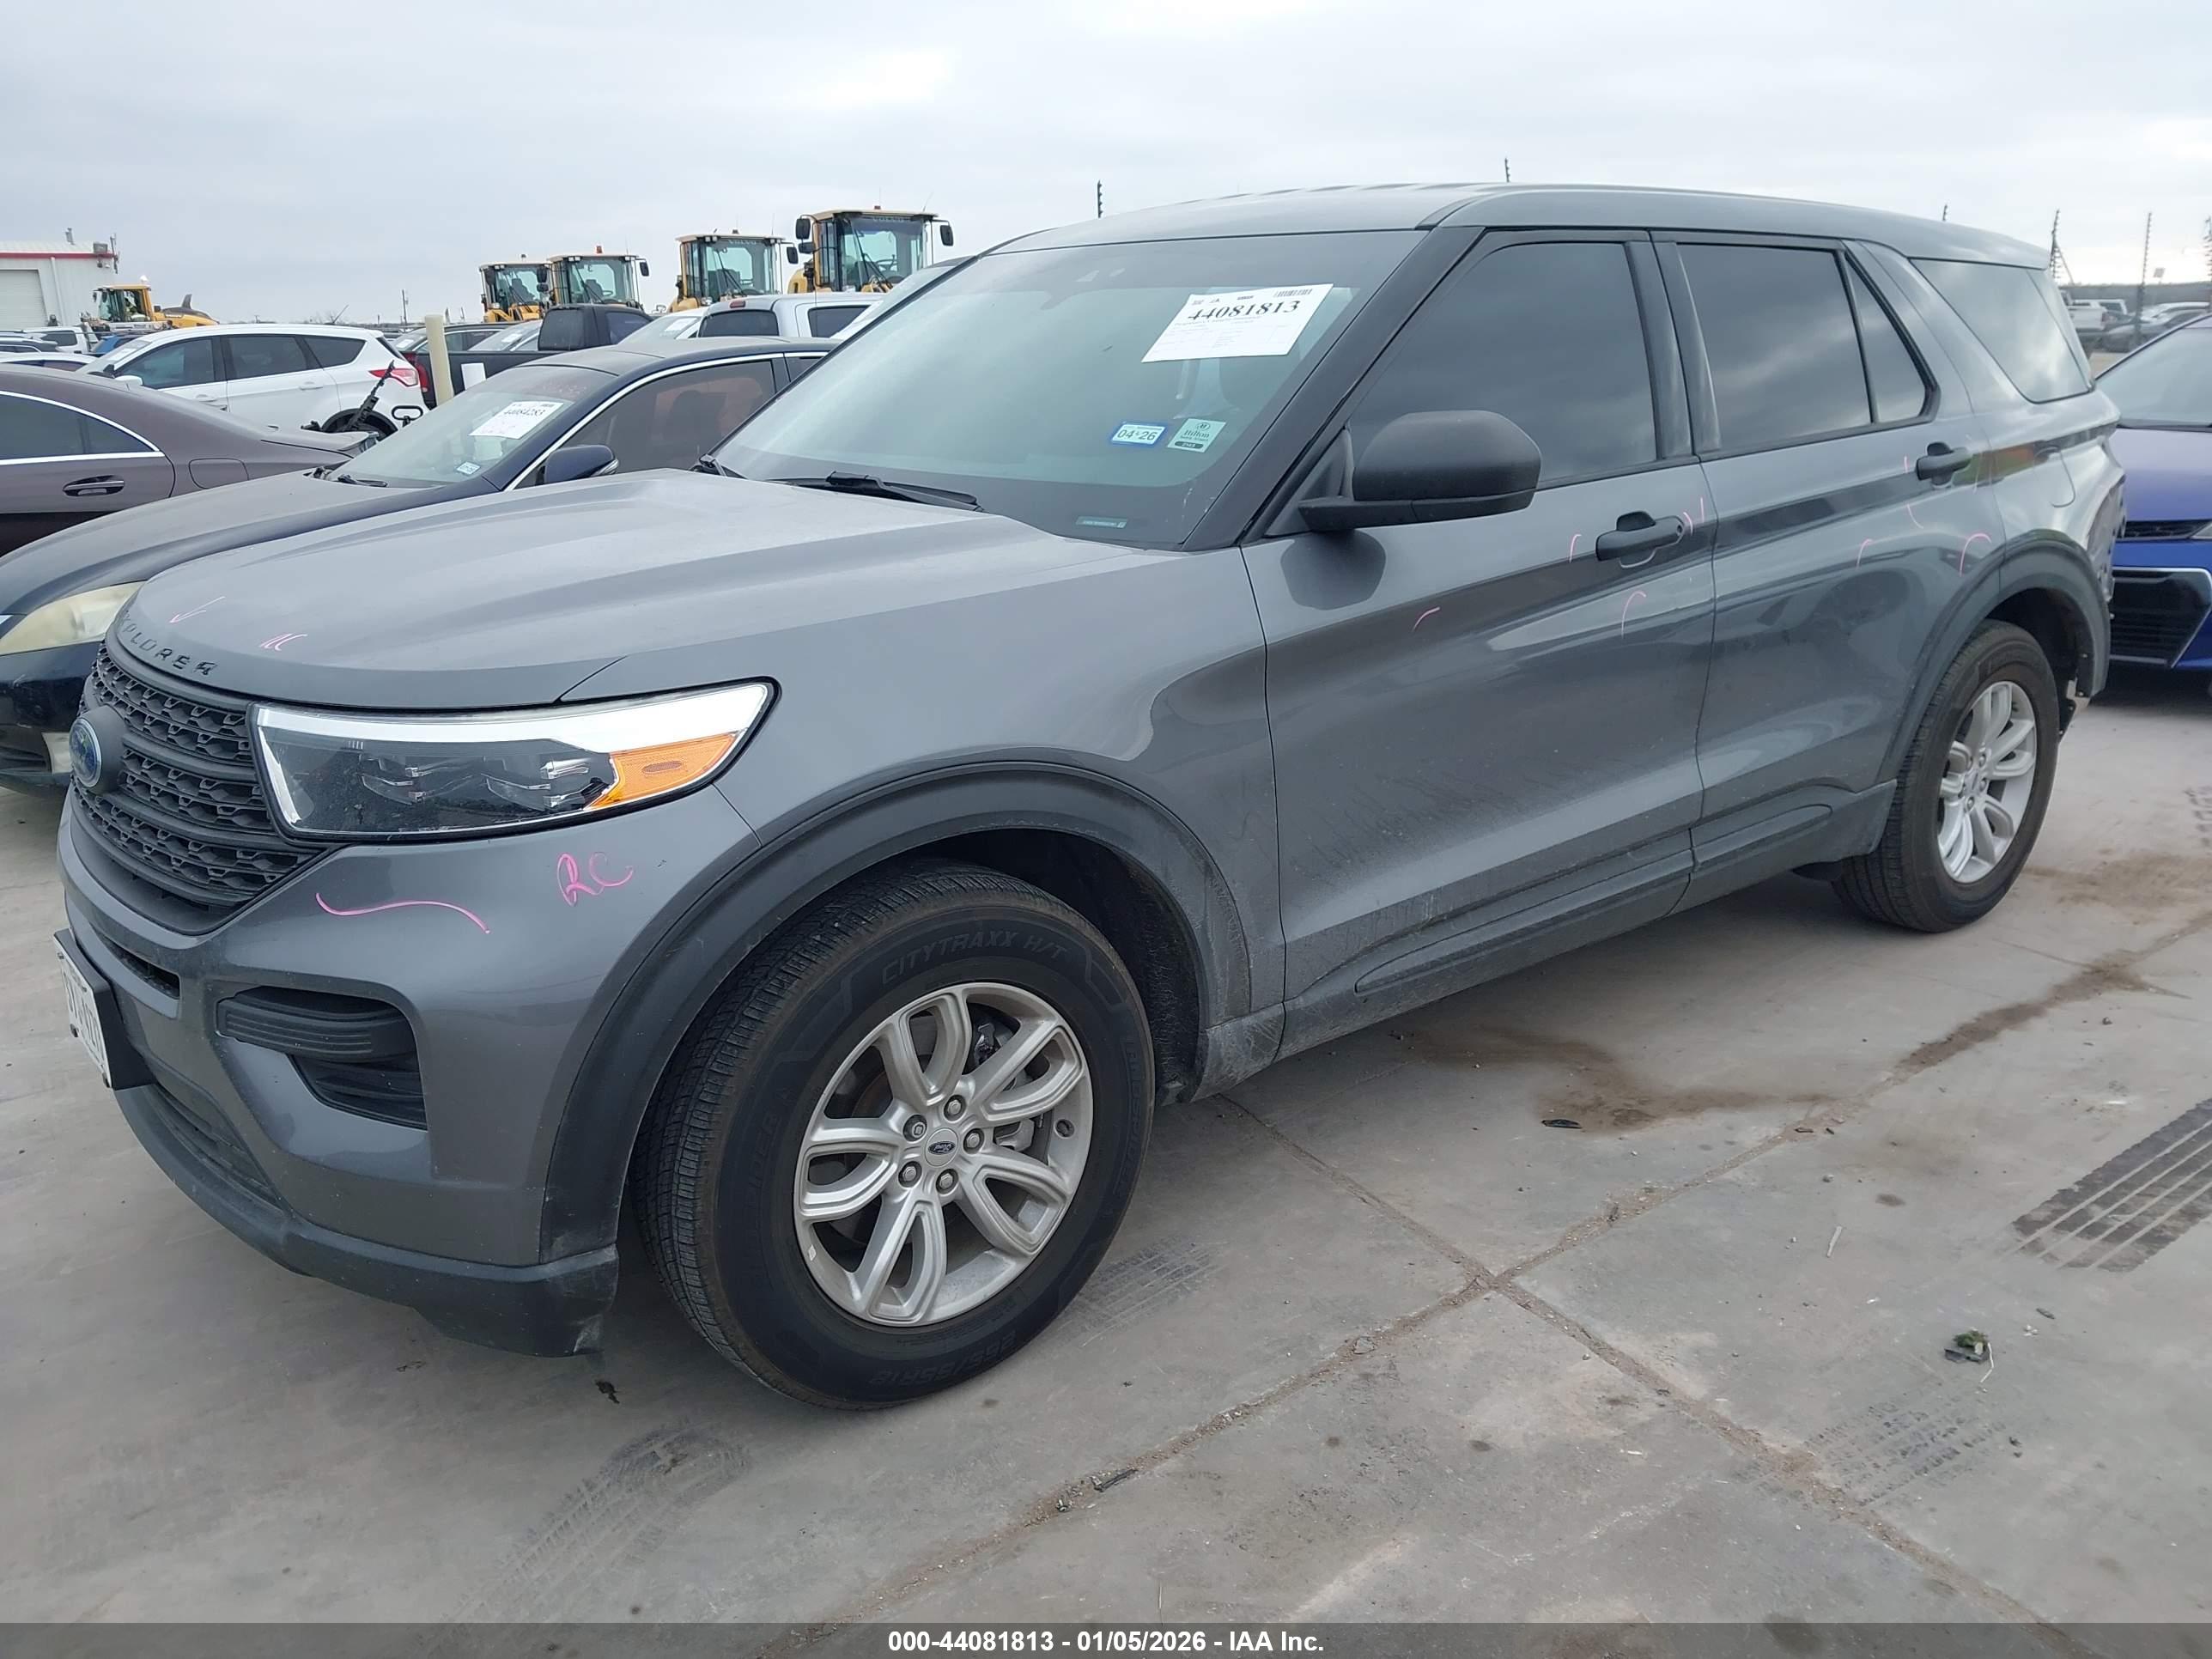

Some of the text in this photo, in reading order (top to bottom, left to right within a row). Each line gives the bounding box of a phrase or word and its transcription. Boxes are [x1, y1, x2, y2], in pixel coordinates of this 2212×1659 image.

[1188, 300, 1300, 320] 44081813
[1117, 429, 1158, 441] 04 26
[882, 931, 1018, 985] CITYTRAXX
